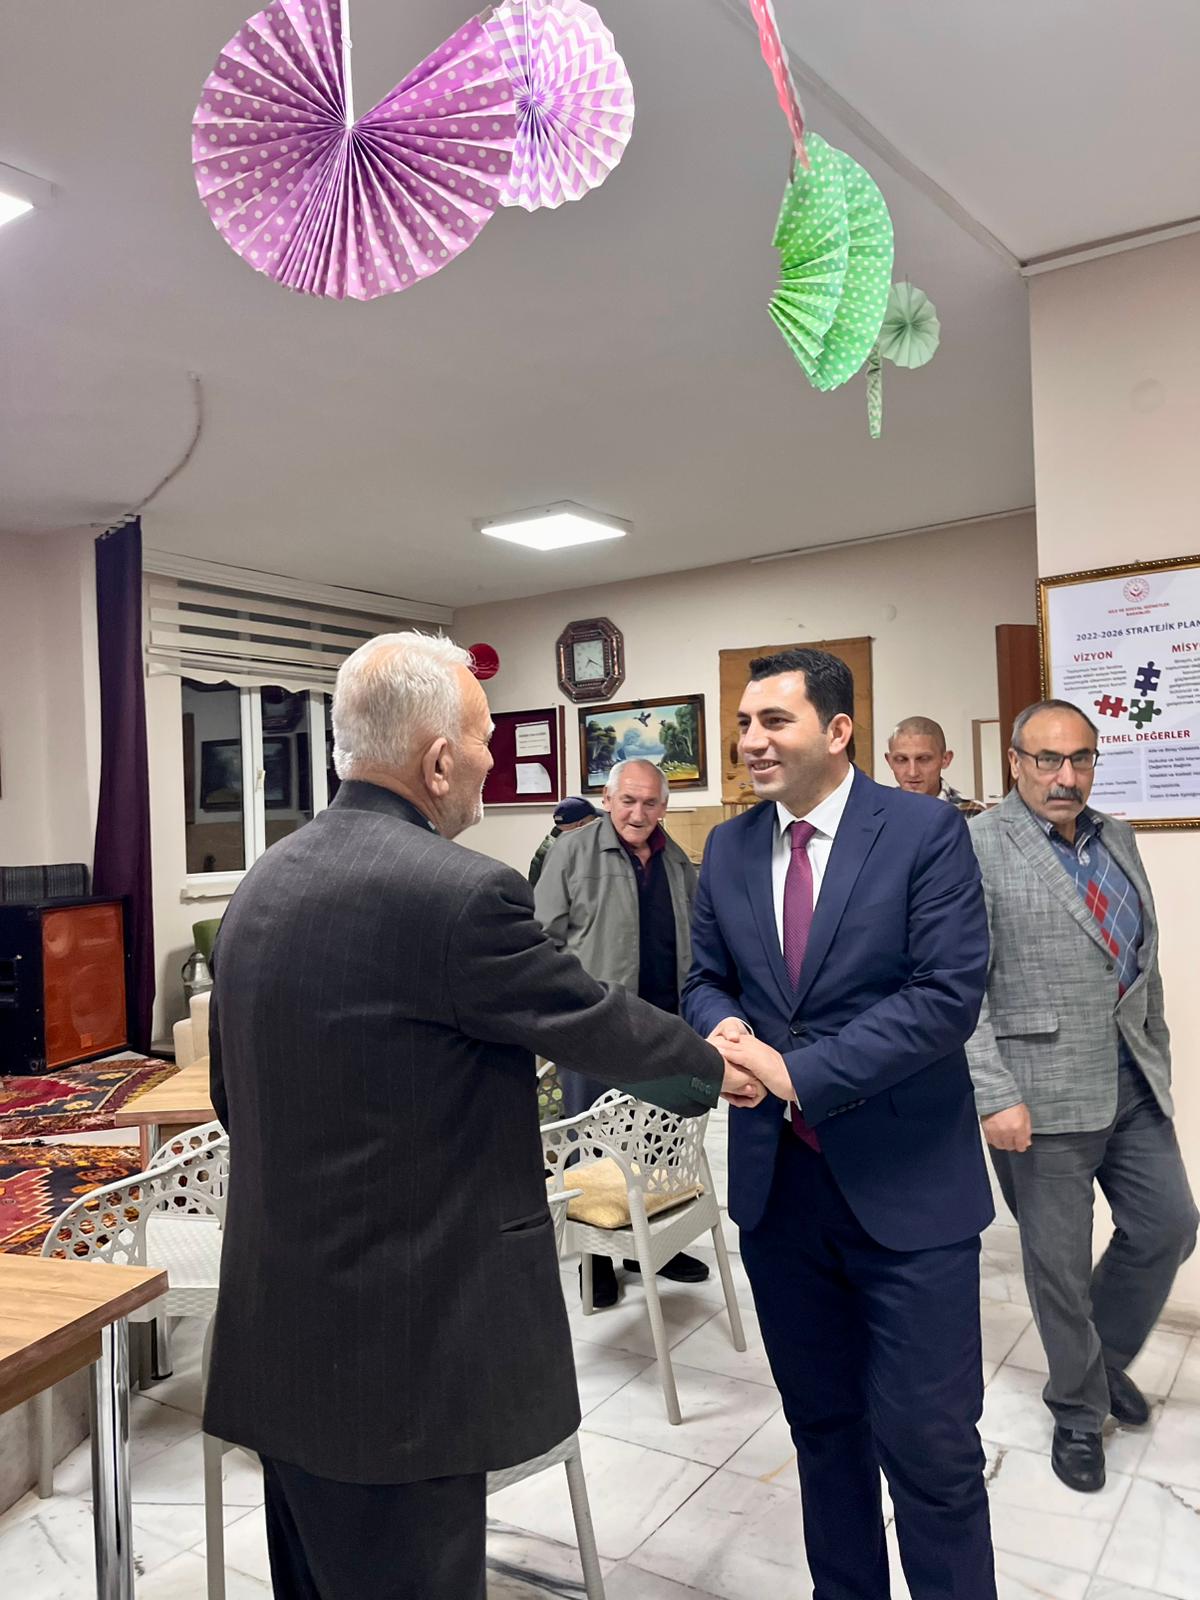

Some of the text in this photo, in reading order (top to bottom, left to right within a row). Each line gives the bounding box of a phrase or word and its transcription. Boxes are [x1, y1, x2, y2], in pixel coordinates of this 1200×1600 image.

[1076, 629, 1123, 641] 2022-2026
[1125, 621, 1175, 636] STRATEJİK
[1172, 642, 1200, 653] MİSY
[1073, 650, 1113, 662] VİZYON
[1100, 729, 1191, 744] TEMEL DEĞERLER
